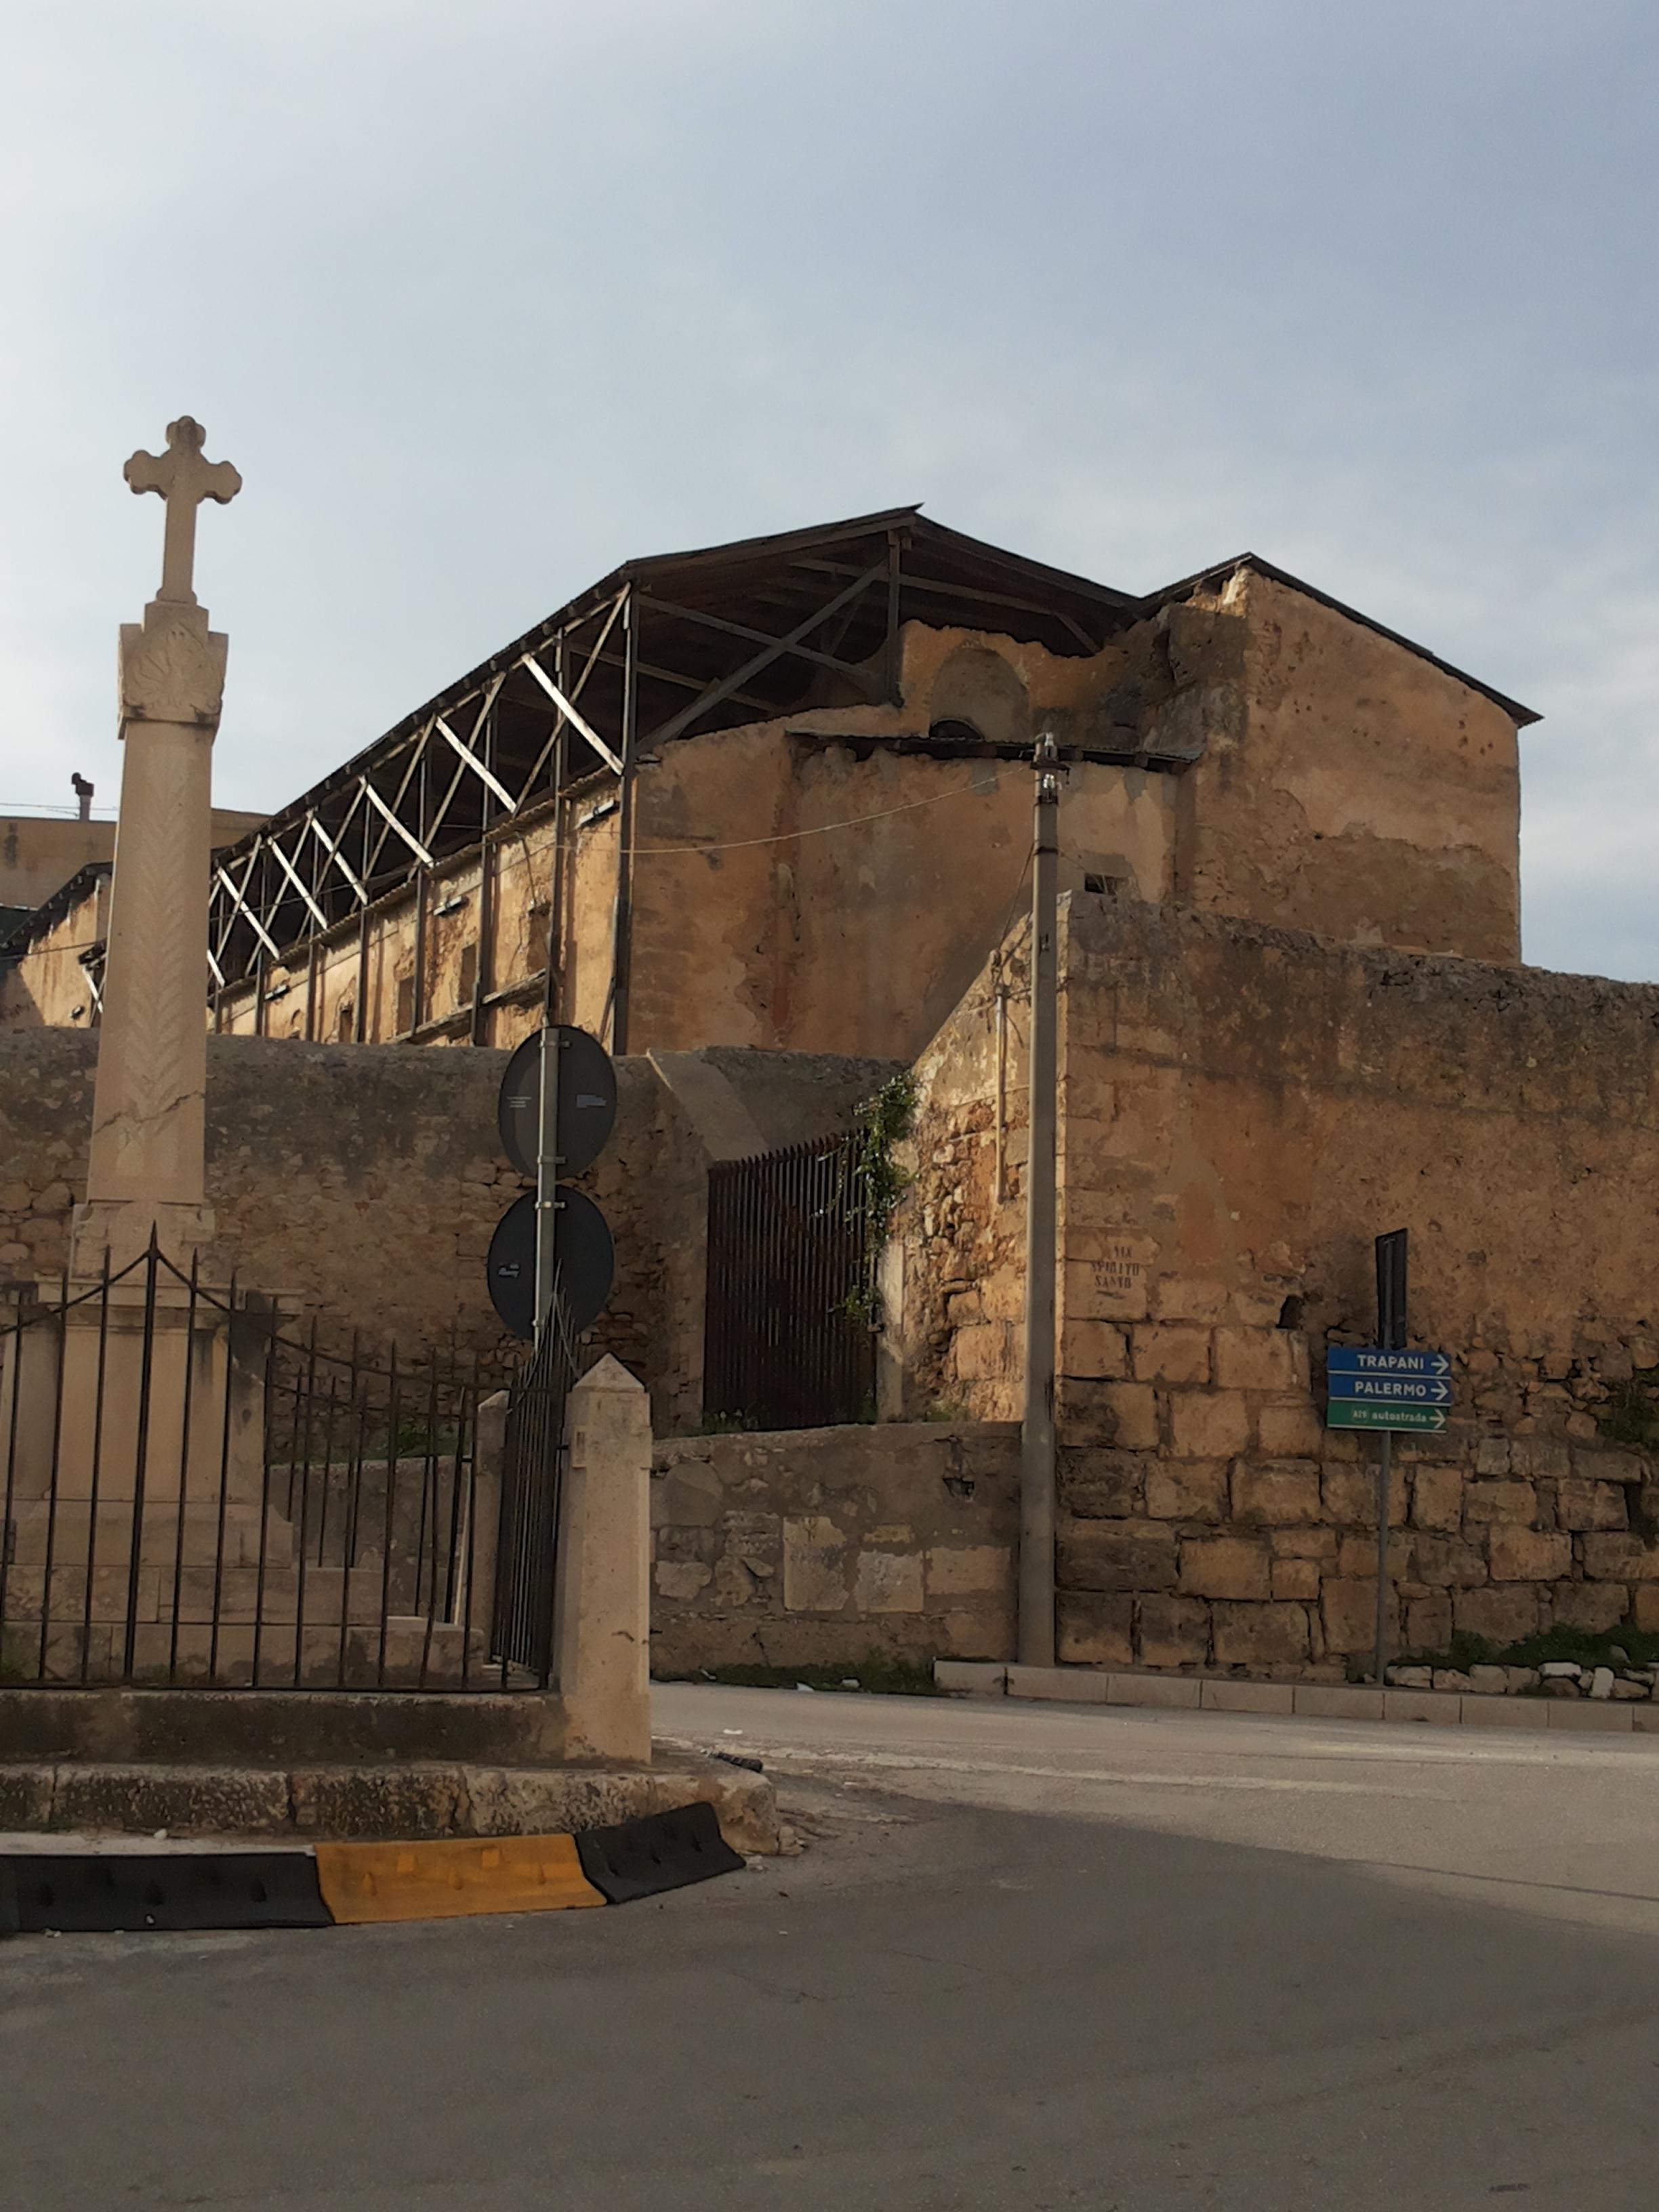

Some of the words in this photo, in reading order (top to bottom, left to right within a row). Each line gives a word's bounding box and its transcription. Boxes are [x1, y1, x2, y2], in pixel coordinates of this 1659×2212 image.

[1357, 1355, 1424, 1370] TRAPANI
[1355, 1381, 1427, 1396] PALERMO
[1372, 1411, 1427, 1422] autostrada
